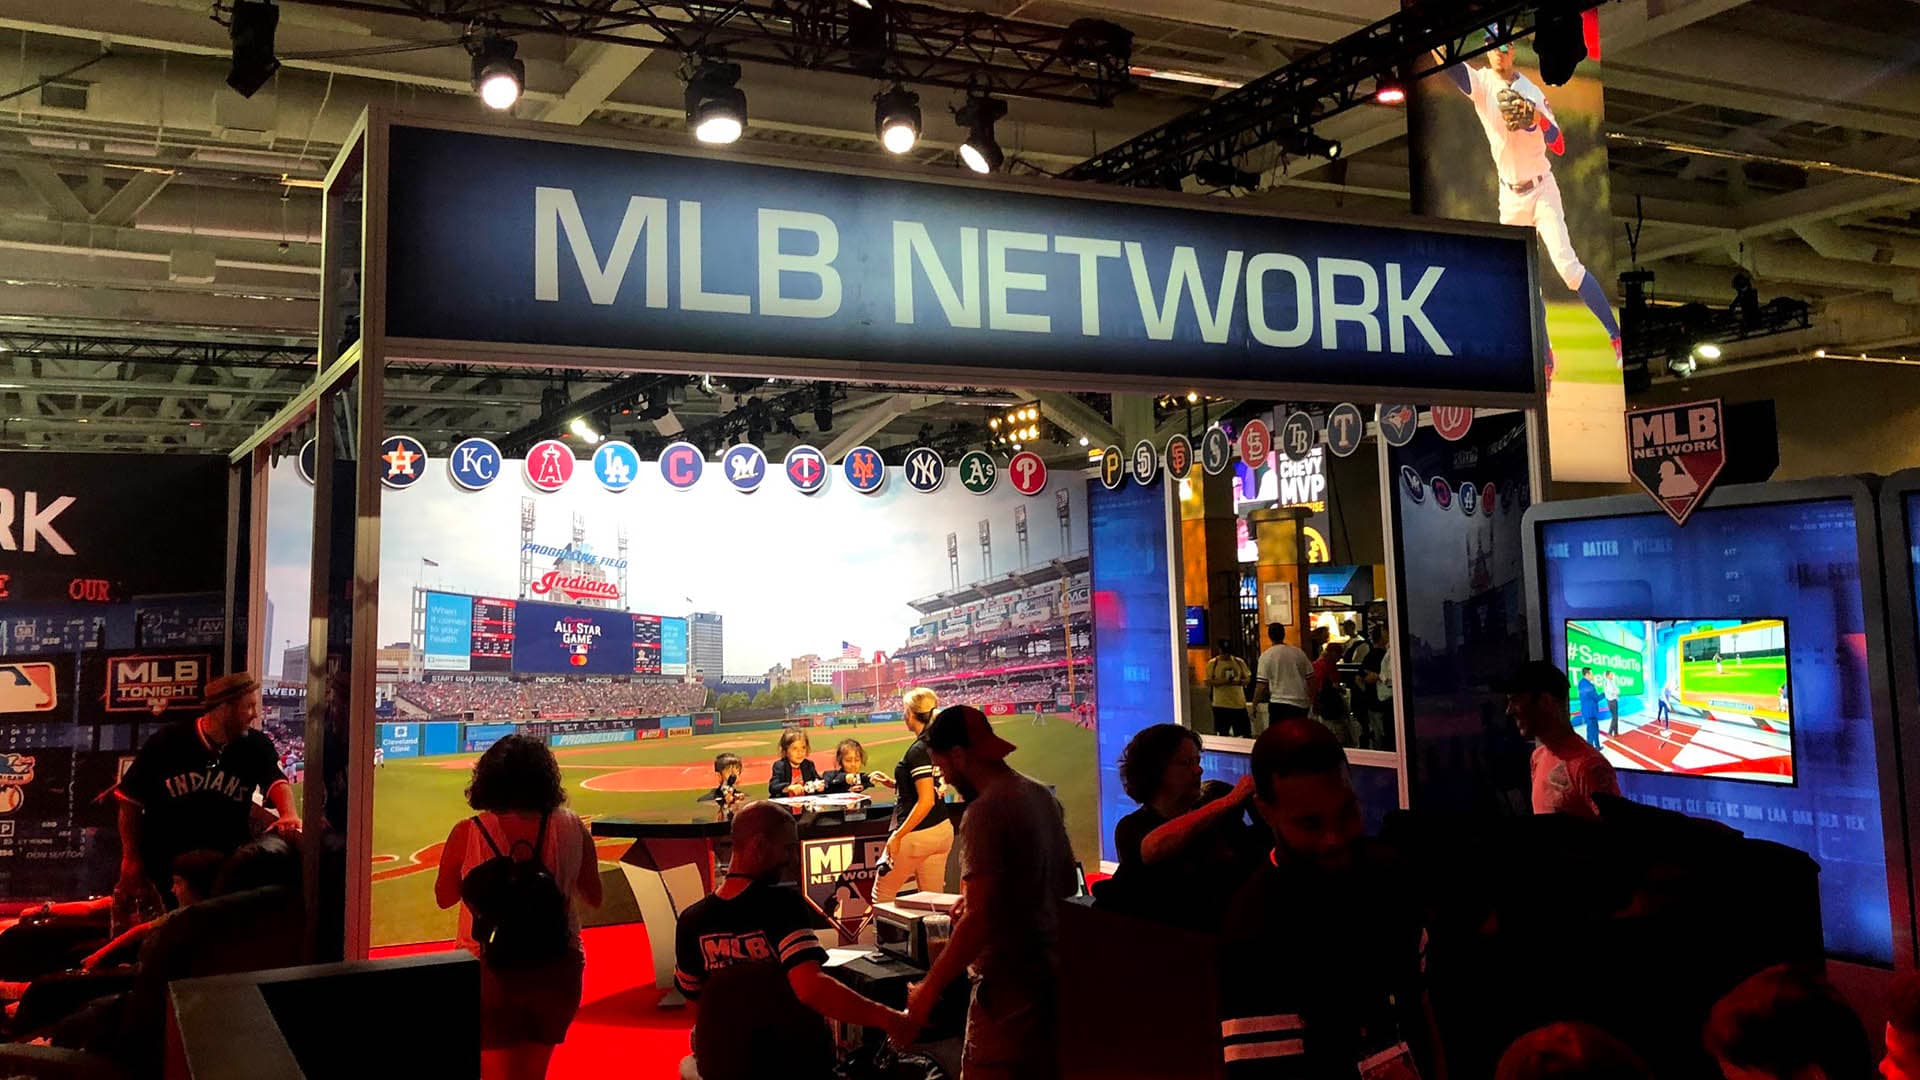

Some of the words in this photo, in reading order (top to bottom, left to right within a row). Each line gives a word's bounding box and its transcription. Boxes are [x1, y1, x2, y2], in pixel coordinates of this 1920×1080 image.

[534, 186, 843, 319] MLB
[892, 221, 1454, 357] NETWORK
[1288, 422, 1309, 454] TB
[1334, 413, 1354, 448] T
[1632, 407, 1718, 448] MLB
[1634, 440, 1720, 459] NETWORK
[391, 451, 411, 475] H
[460, 447, 495, 480] KC
[537, 450, 564, 484] A
[603, 447, 630, 484] LA
[669, 450, 694, 483] C
[852, 452, 875, 487] NY
[911, 454, 937, 485] NY
[1015, 457, 1036, 489] P
[1106, 452, 1119, 484] P
[1281, 457, 1322, 477] CHEVY
[1281, 474, 1326, 505] MVP
[1583, 540, 1618, 557] BATTER
[599, 556, 628, 570] FIELD
[69, 579, 110, 601] OUR
[531, 570, 620, 600] Indians
[202, 622, 224, 631] AV
[554, 620, 573, 633] ALL
[576, 622, 601, 637] STAR
[562, 632, 593, 645] GAME
[117, 661, 200, 683] MLB
[432, 675, 454, 683] START
[536, 676, 566, 684] NOCO
[1568, 667, 1635, 688] Tehow
[118, 685, 198, 699] TONIGHT
[383, 737, 418, 746] Cleveland
[390, 745, 410, 753] Clinic
[165, 771, 249, 802] INDIANS
[1846, 815, 1865, 831] TEX
[810, 841, 887, 875] MLB
[811, 871, 877, 885] NETWOR
[704, 936, 770, 960] MLB
